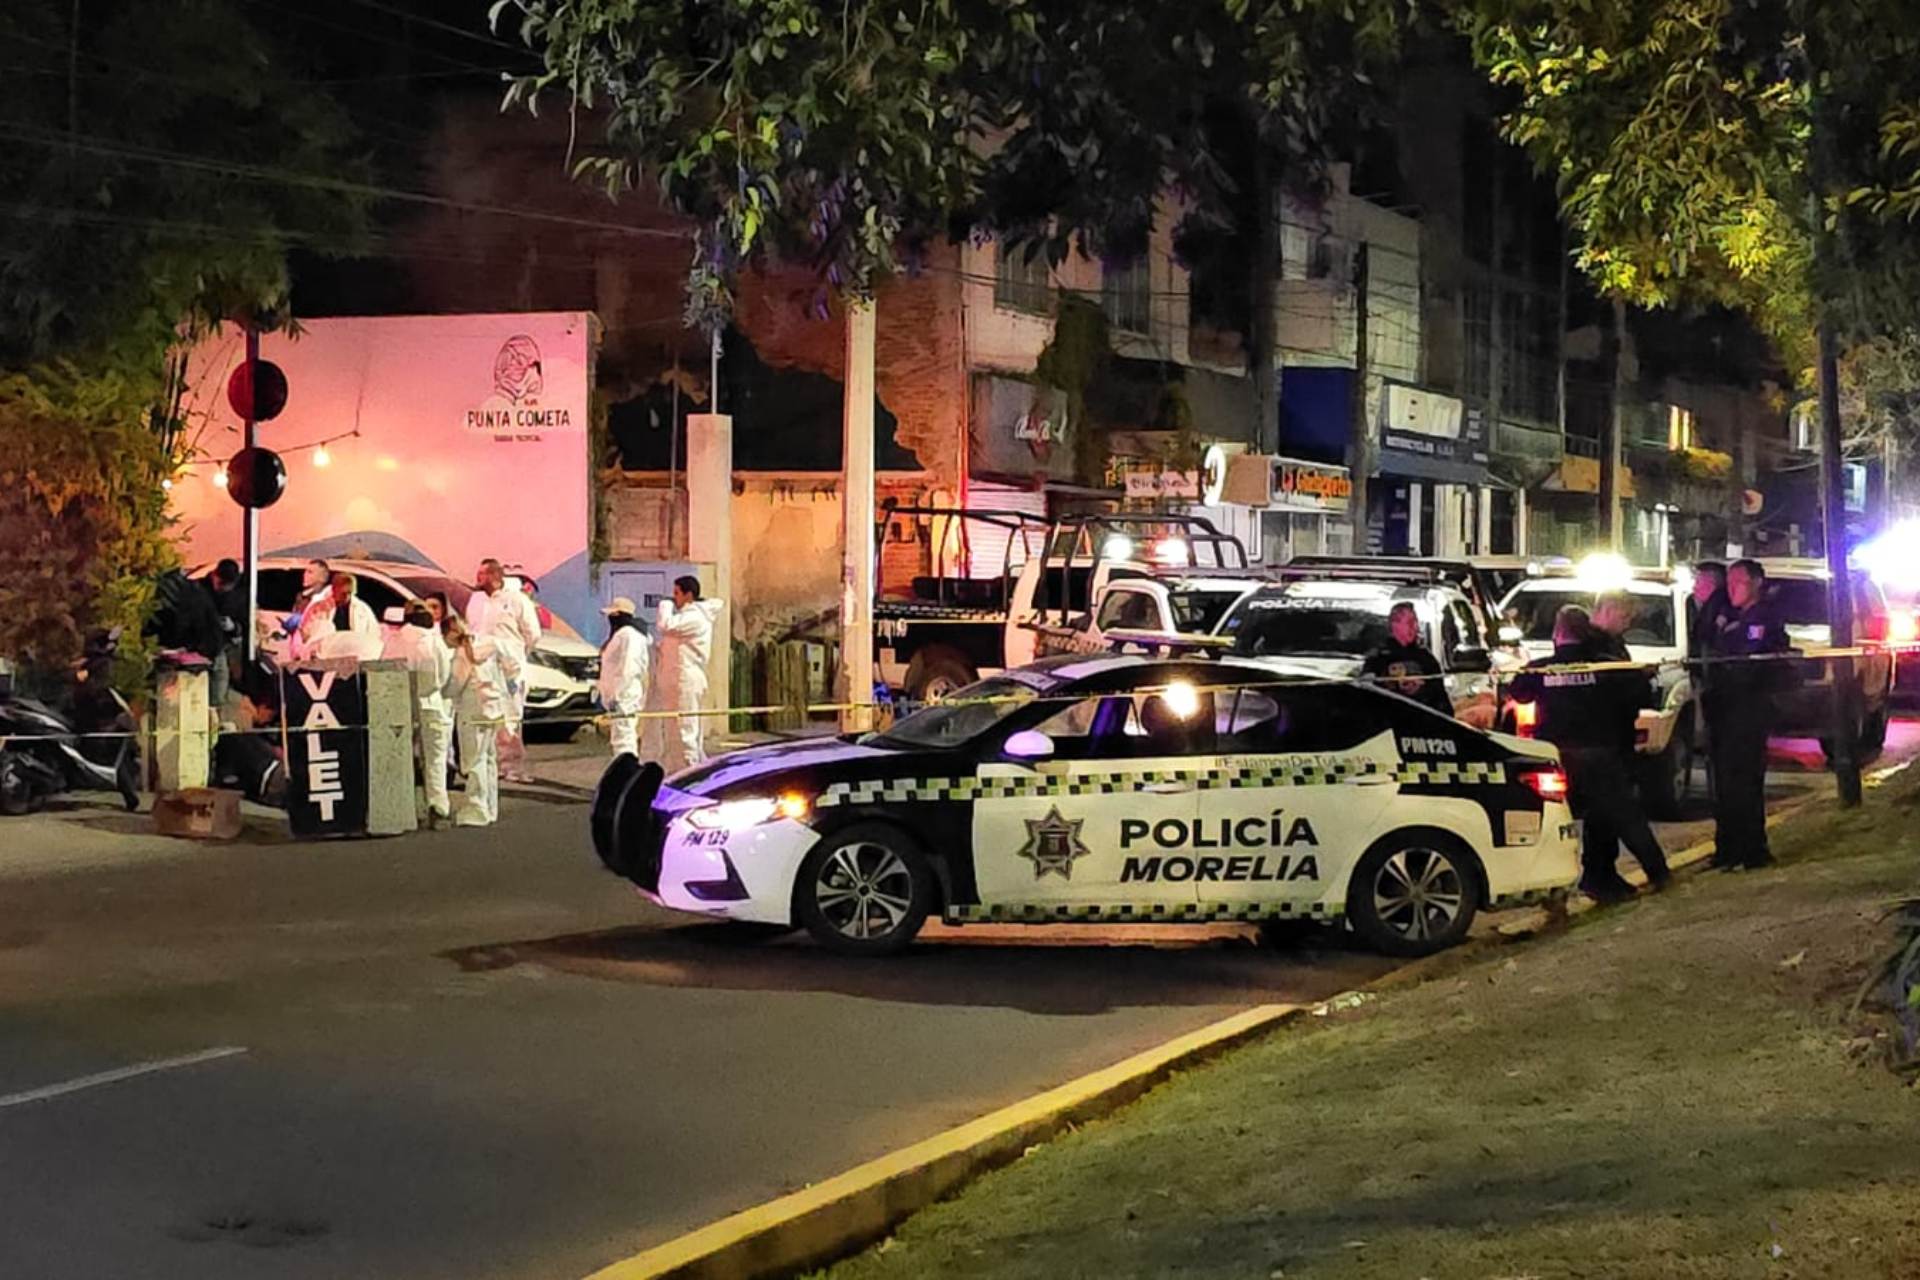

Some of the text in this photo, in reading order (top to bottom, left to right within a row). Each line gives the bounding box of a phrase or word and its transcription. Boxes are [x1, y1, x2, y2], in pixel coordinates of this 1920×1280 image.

[467, 410, 571, 428] PUNTA COMETA
[298, 670, 345, 822] VALET
[1401, 736, 1457, 756] PM129
[681, 829, 730, 847] PM 129
[1120, 808, 1319, 849] POLICÍA
[1119, 855, 1320, 884] MORELIA
